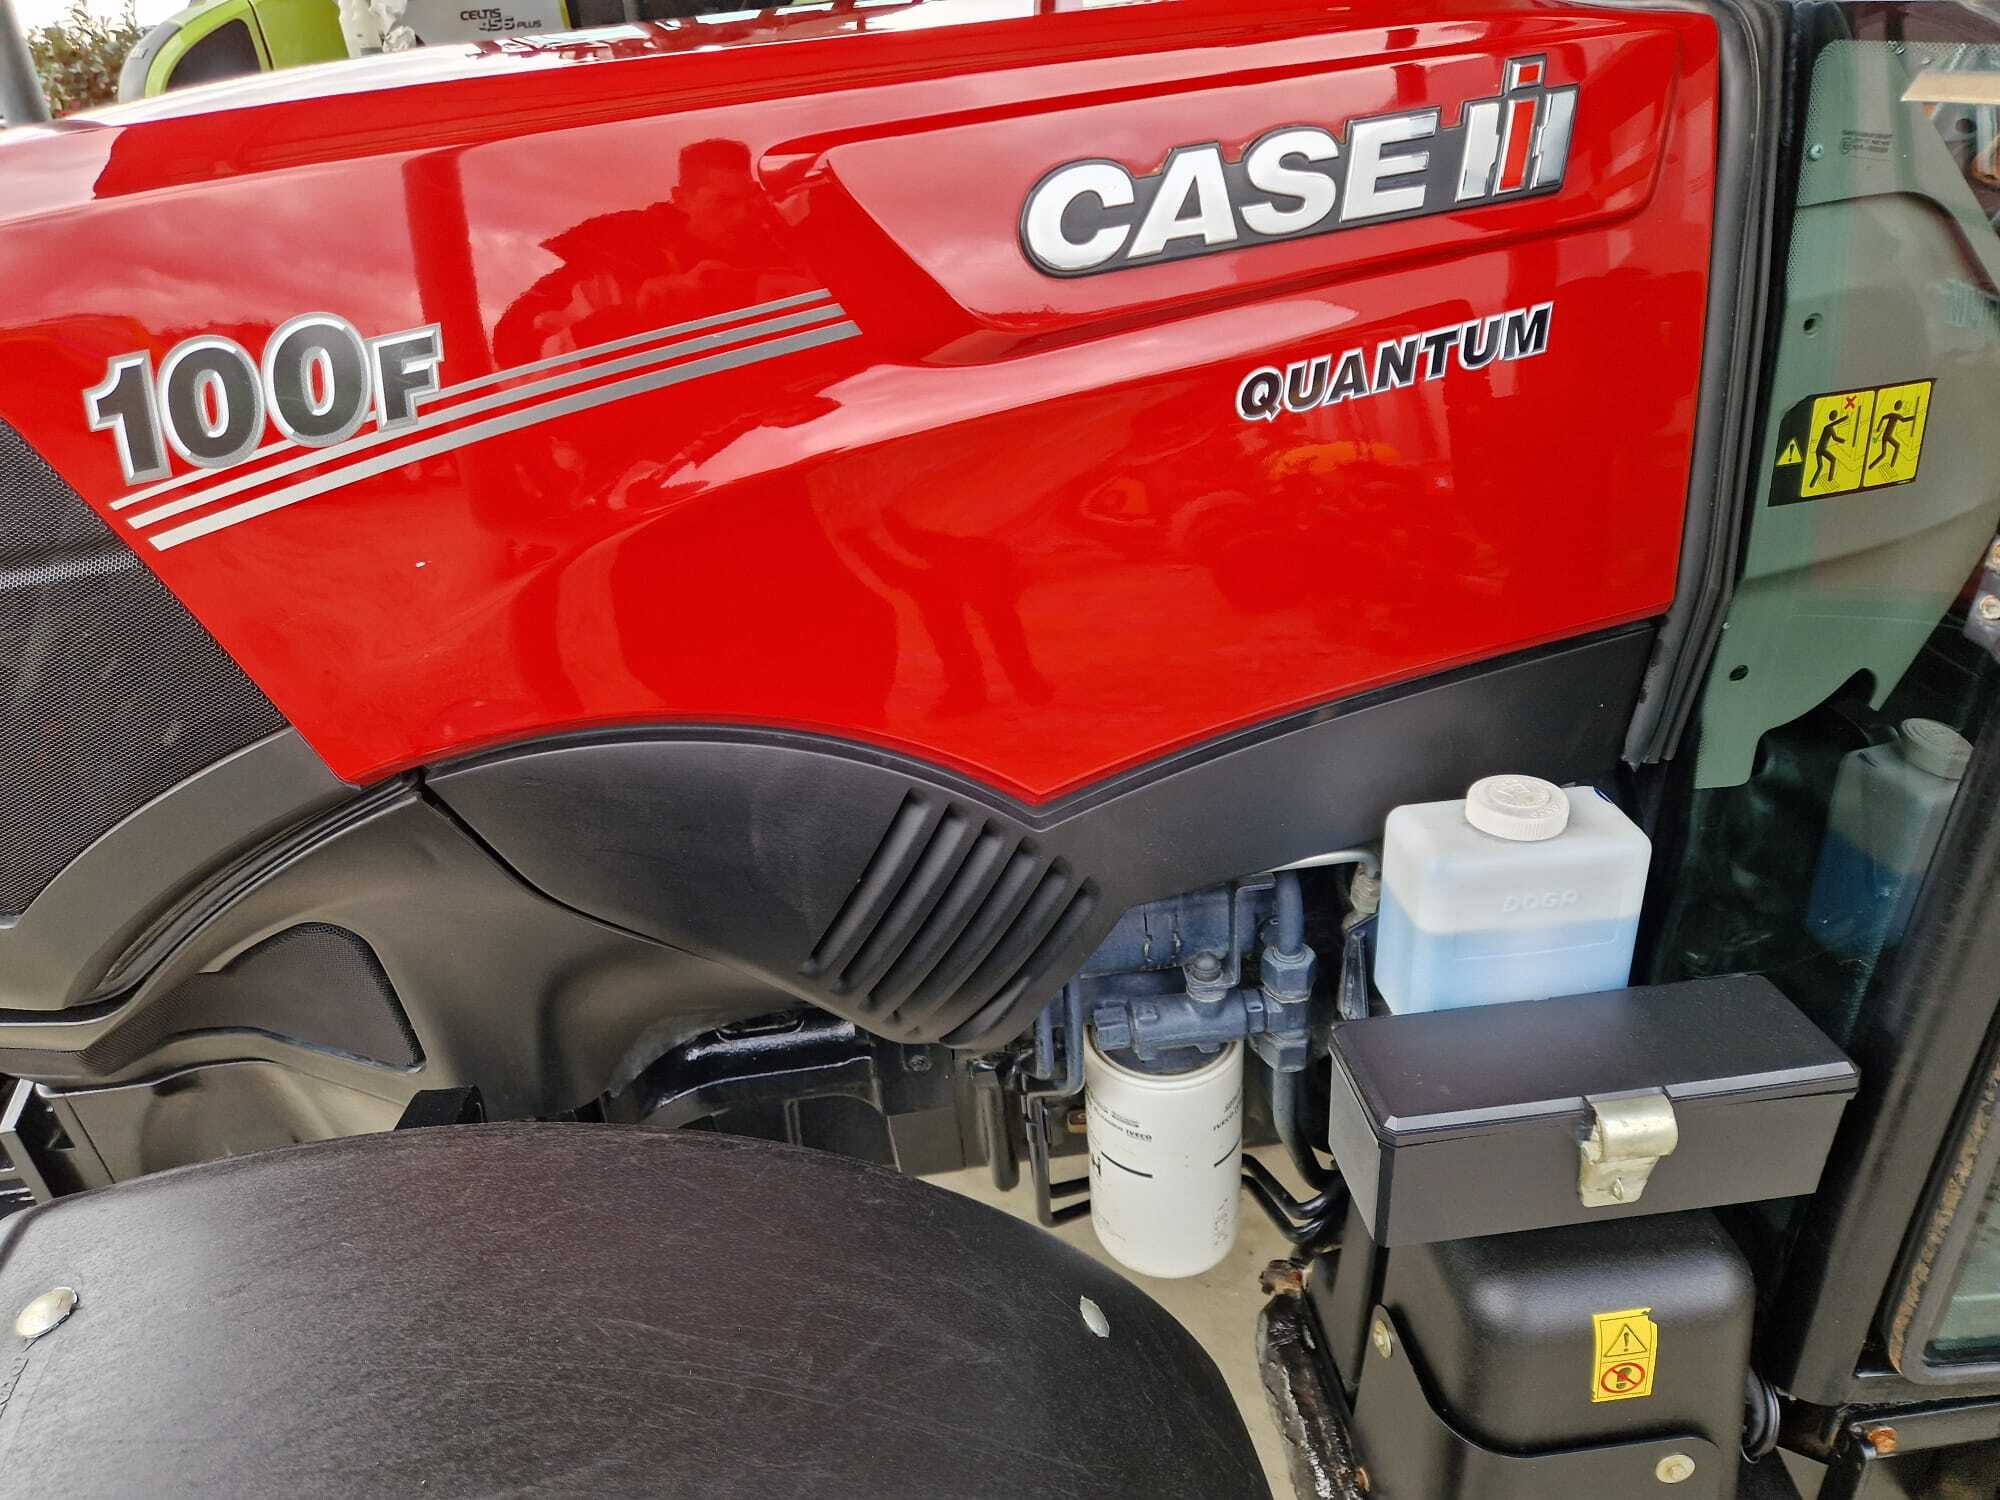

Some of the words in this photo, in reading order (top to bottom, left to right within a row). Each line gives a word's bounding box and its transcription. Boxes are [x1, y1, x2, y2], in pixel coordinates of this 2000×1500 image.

[460, 8, 502, 21] CELTIS
[516, 19, 542, 30] PLUS
[1023, 109, 1441, 274] CASE
[1235, 302, 1554, 422] QUANTUM
[83, 312, 445, 486] 100F
[1126, 1128, 1153, 1143] IVECO
